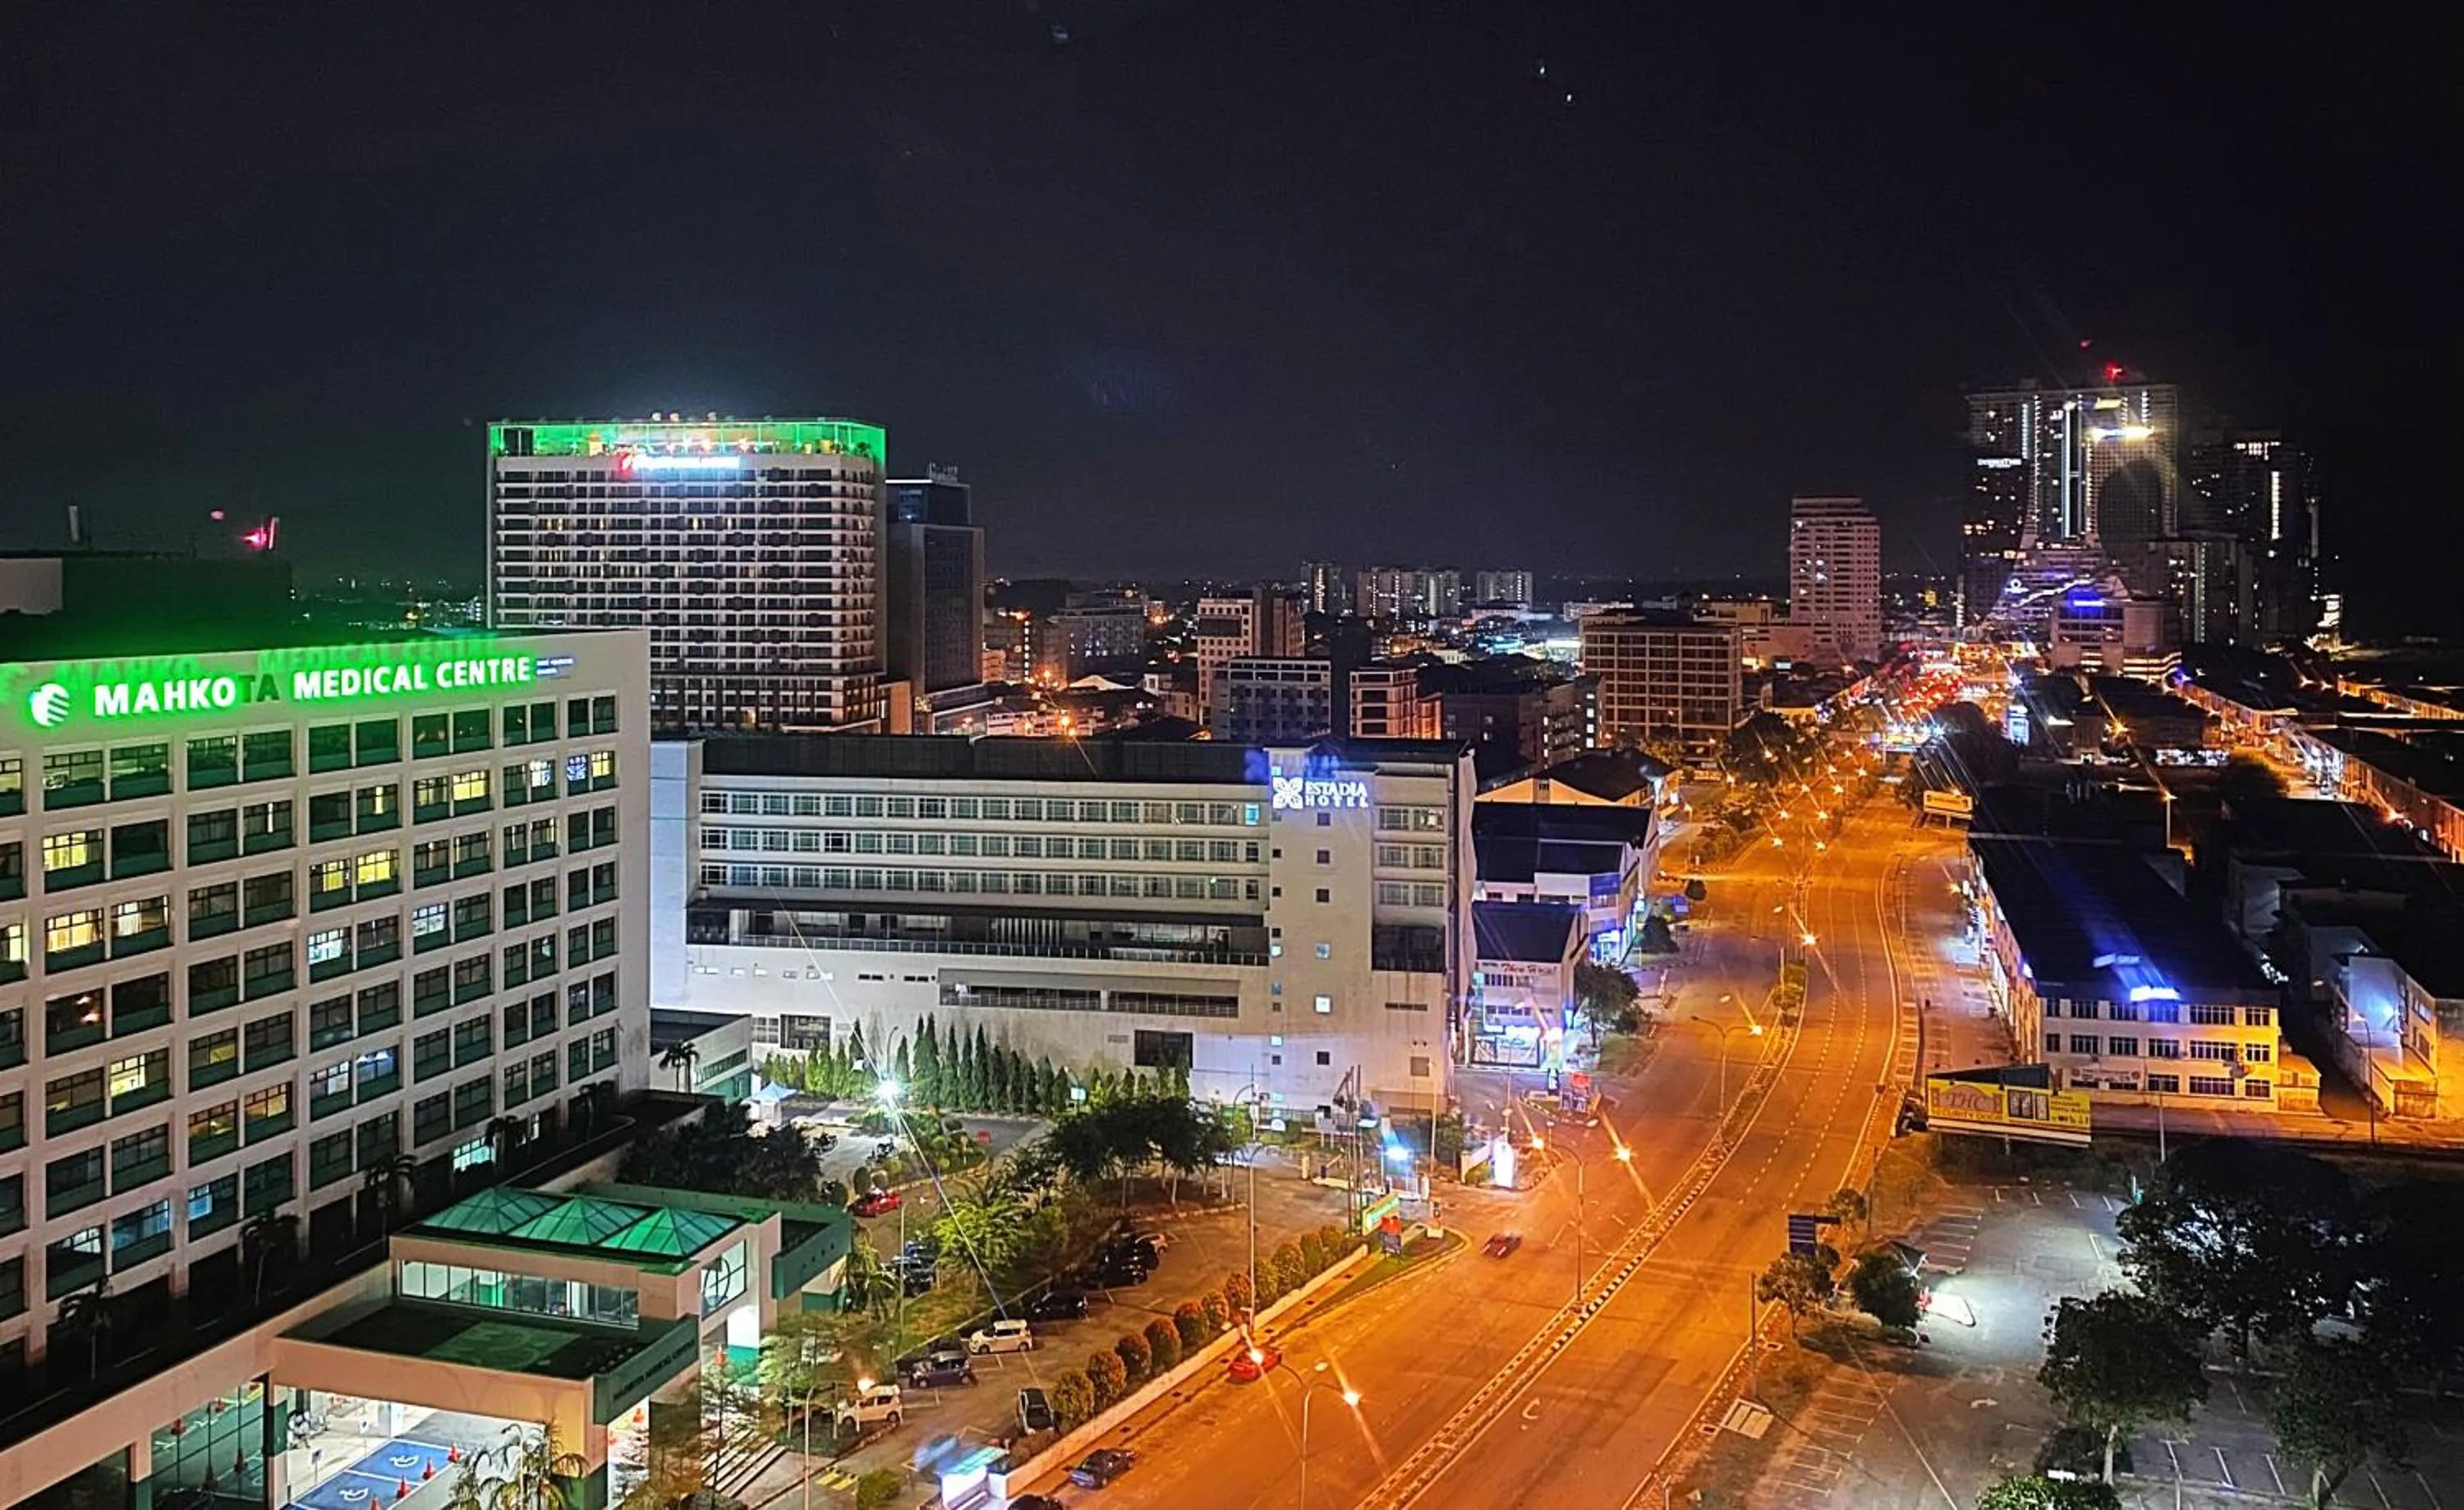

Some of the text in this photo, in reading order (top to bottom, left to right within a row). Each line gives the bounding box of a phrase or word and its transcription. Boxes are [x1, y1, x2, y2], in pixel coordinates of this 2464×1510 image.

[94, 656, 531, 717] MAHKOTA MEDICAL CENTRE
[1305, 781, 1369, 808] ESTADIA HOTEL
